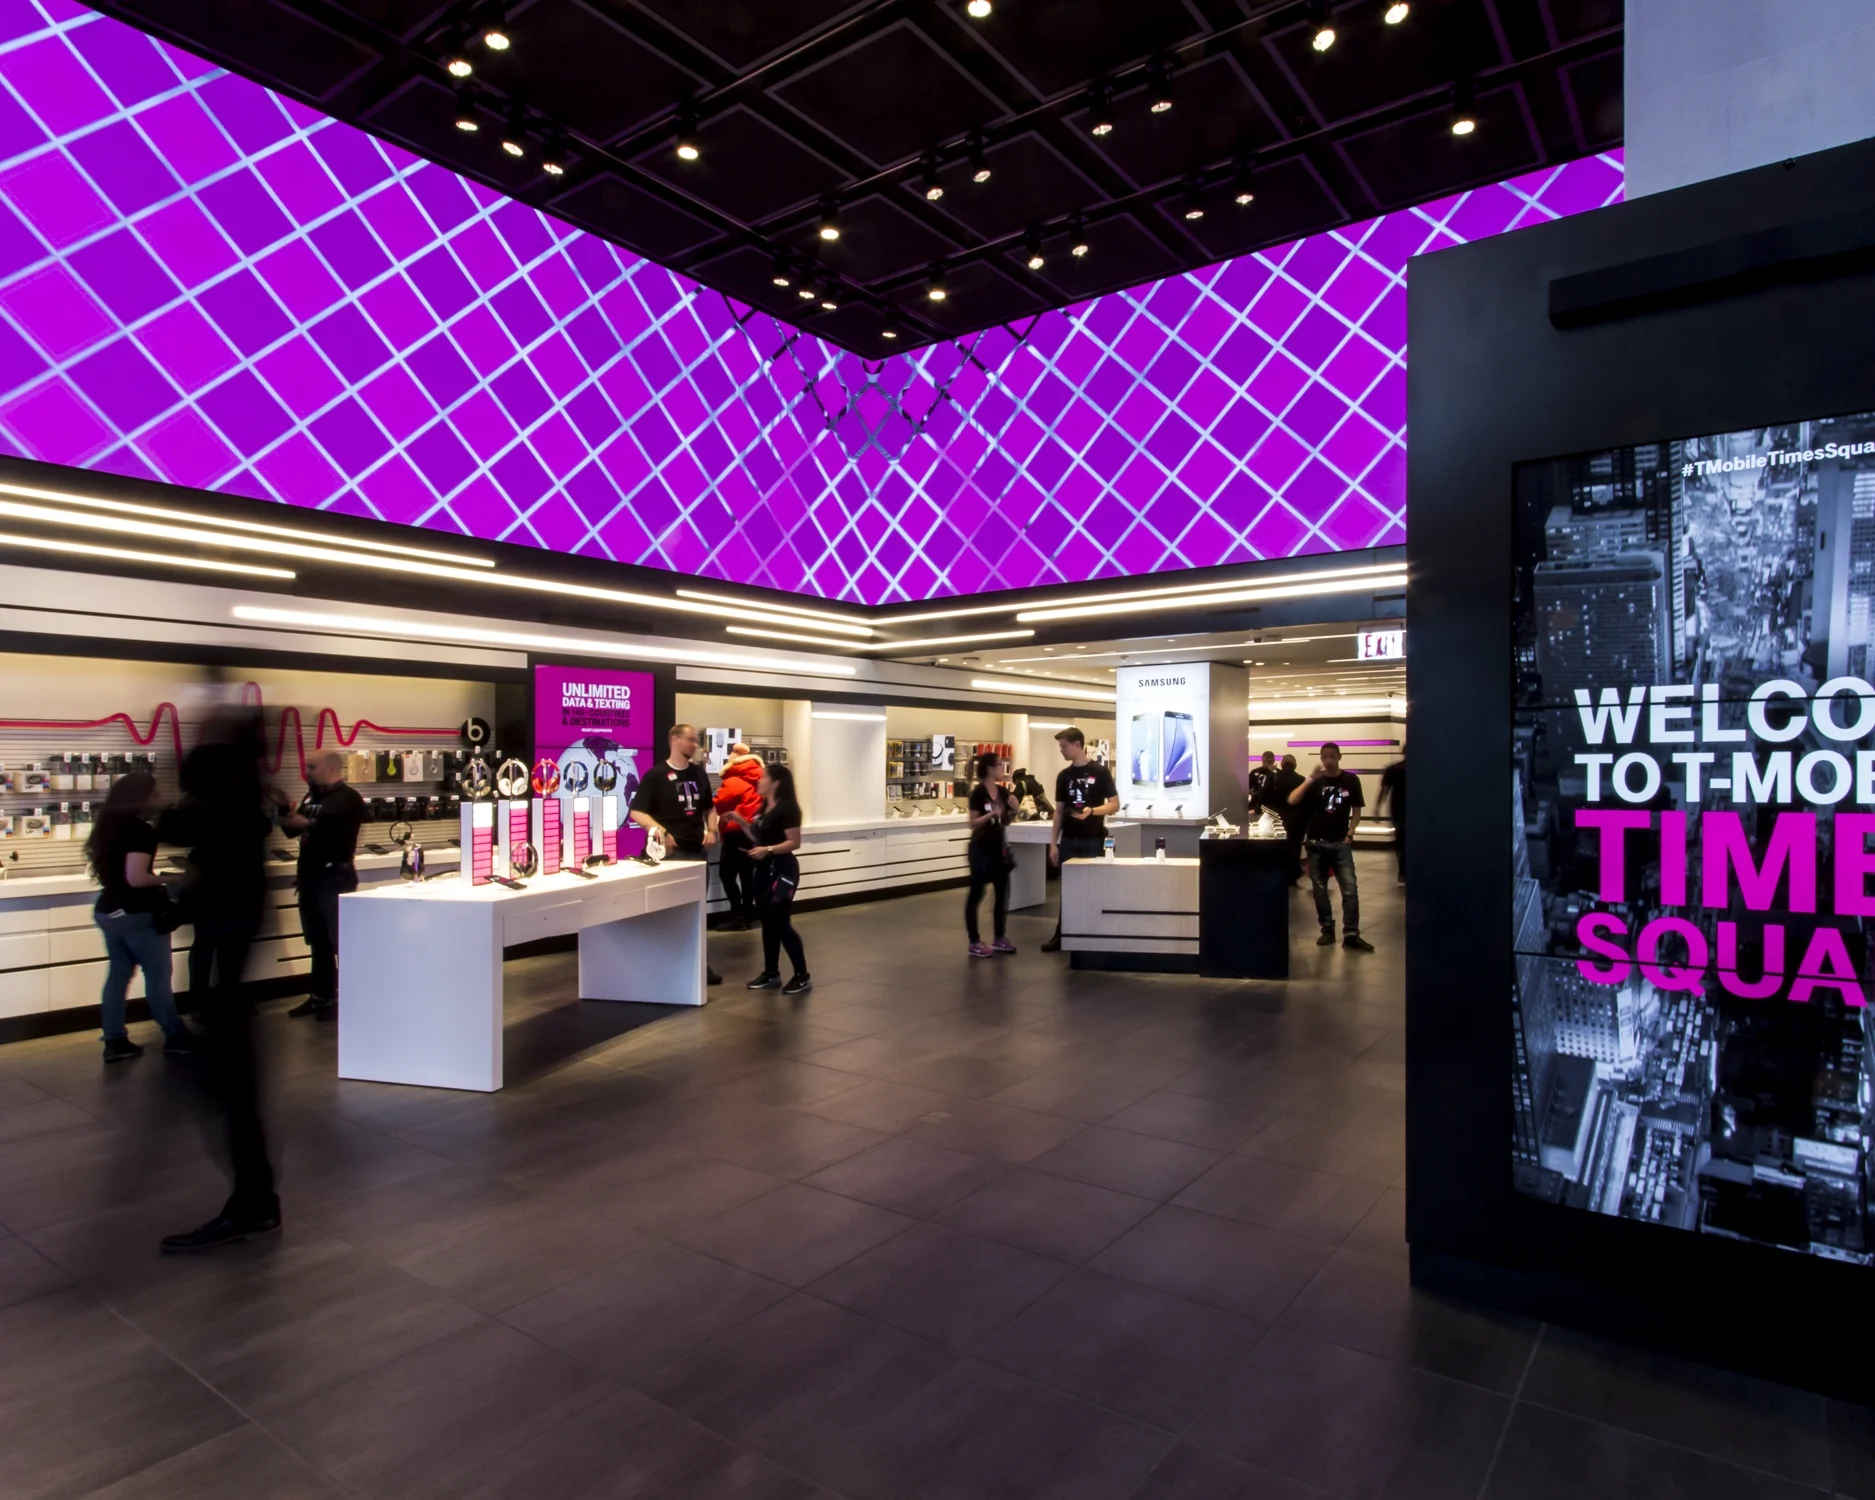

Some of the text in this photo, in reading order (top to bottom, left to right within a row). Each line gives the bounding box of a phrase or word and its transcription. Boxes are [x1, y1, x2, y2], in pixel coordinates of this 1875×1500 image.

[1682, 442, 1875, 477] #TMobileTimesSqua
[562, 682, 631, 699] UNLIMITED
[1138, 677, 1186, 688] SAMSUNG
[562, 697, 631, 710] DATA & TEXTING
[1574, 676, 1875, 744] WELCO
[569, 717, 630, 727] DESTINATIONS
[1574, 753, 1661, 803] TO
[1575, 911, 1867, 1007] SQUA
